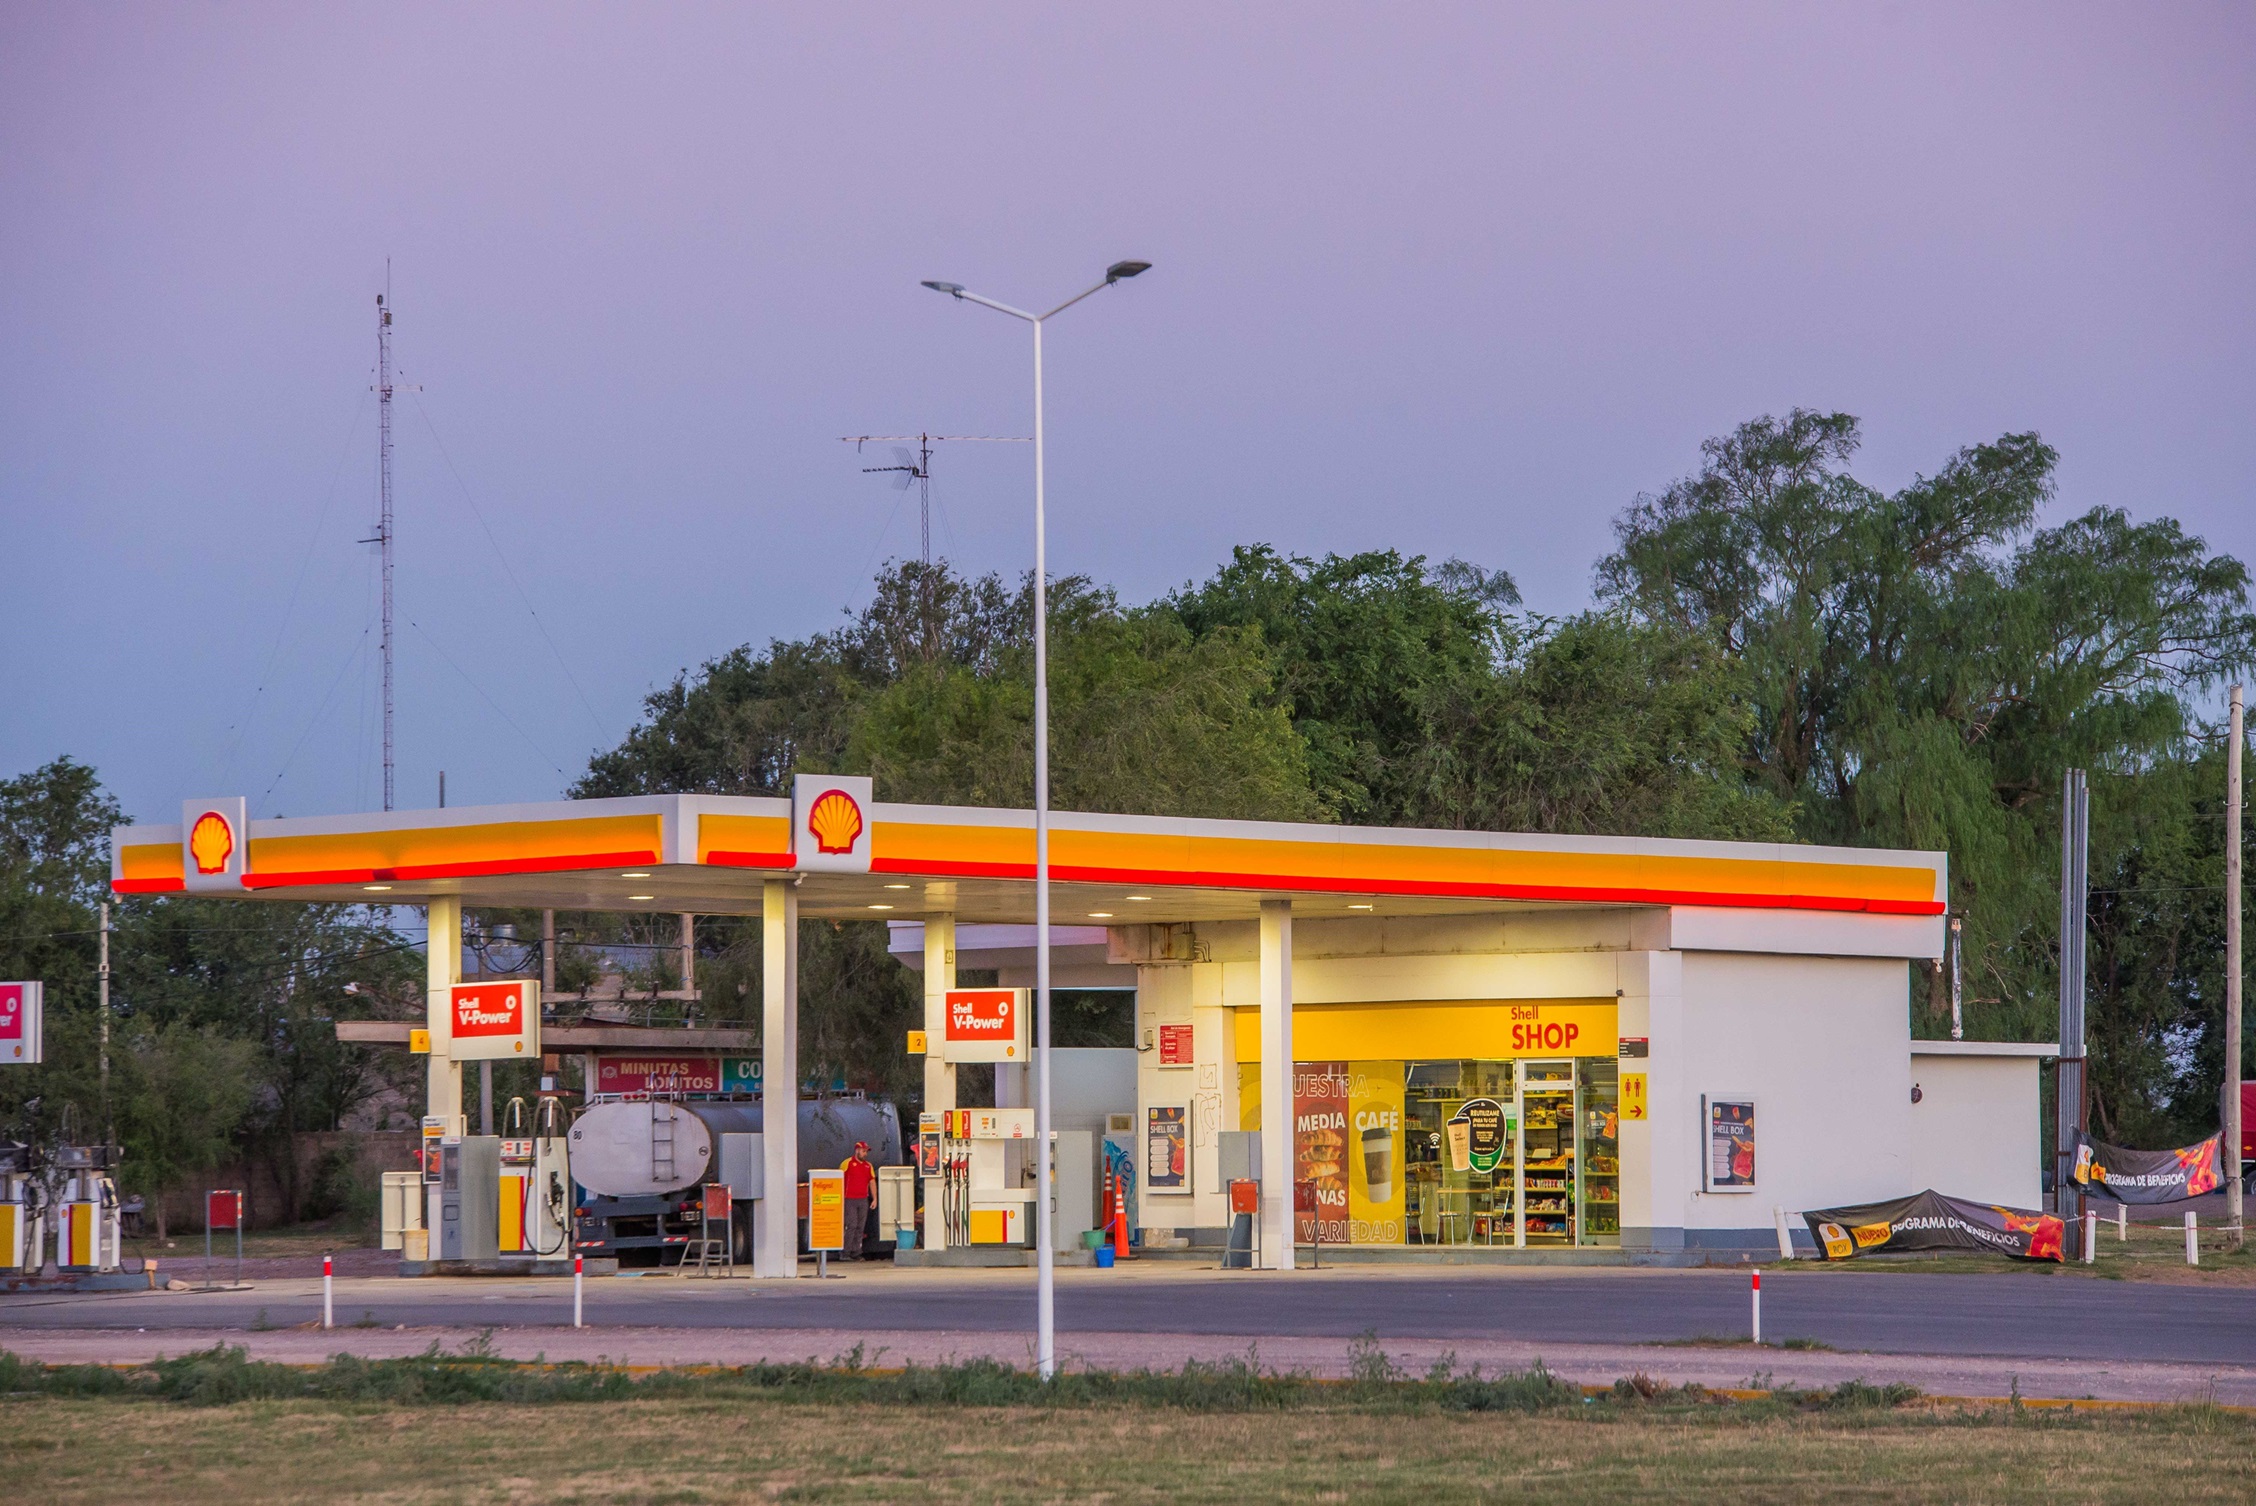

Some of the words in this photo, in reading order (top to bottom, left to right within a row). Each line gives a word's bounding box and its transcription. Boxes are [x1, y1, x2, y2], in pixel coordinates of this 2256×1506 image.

[458, 997, 479, 1010] Shell
[953, 1002, 973, 1014] Shell
[458, 1009, 513, 1025] V-Power
[1511, 1005, 1539, 1020] Shell
[953, 1015, 1005, 1030] V-Power
[916, 1038, 921, 1047] 2
[1512, 1022, 1579, 1050] SHOP
[620, 1062, 689, 1076] MINUTAS
[644, 1076, 714, 1090] LOMITOS
[1293, 1074, 1370, 1098] UESTRA
[1297, 1111, 1346, 1133] MEDIA
[1355, 1104, 1399, 1132] CAFÉ
[573, 1130, 583, 1140] 80
[1150, 1125, 1166, 1134] SHELL
[1167, 1125, 1178, 1133] BOX
[1713, 1125, 1729, 1134] SHELL
[1730, 1126, 1744, 1135] BOX
[2137, 1173, 2146, 1186] DE
[1316, 1189, 1346, 1207] NAS
[1302, 1219, 1398, 1242] VARIEDAD
[1857, 1226, 1888, 1242] NUEVO
[1833, 1244, 1848, 1255] BOX
